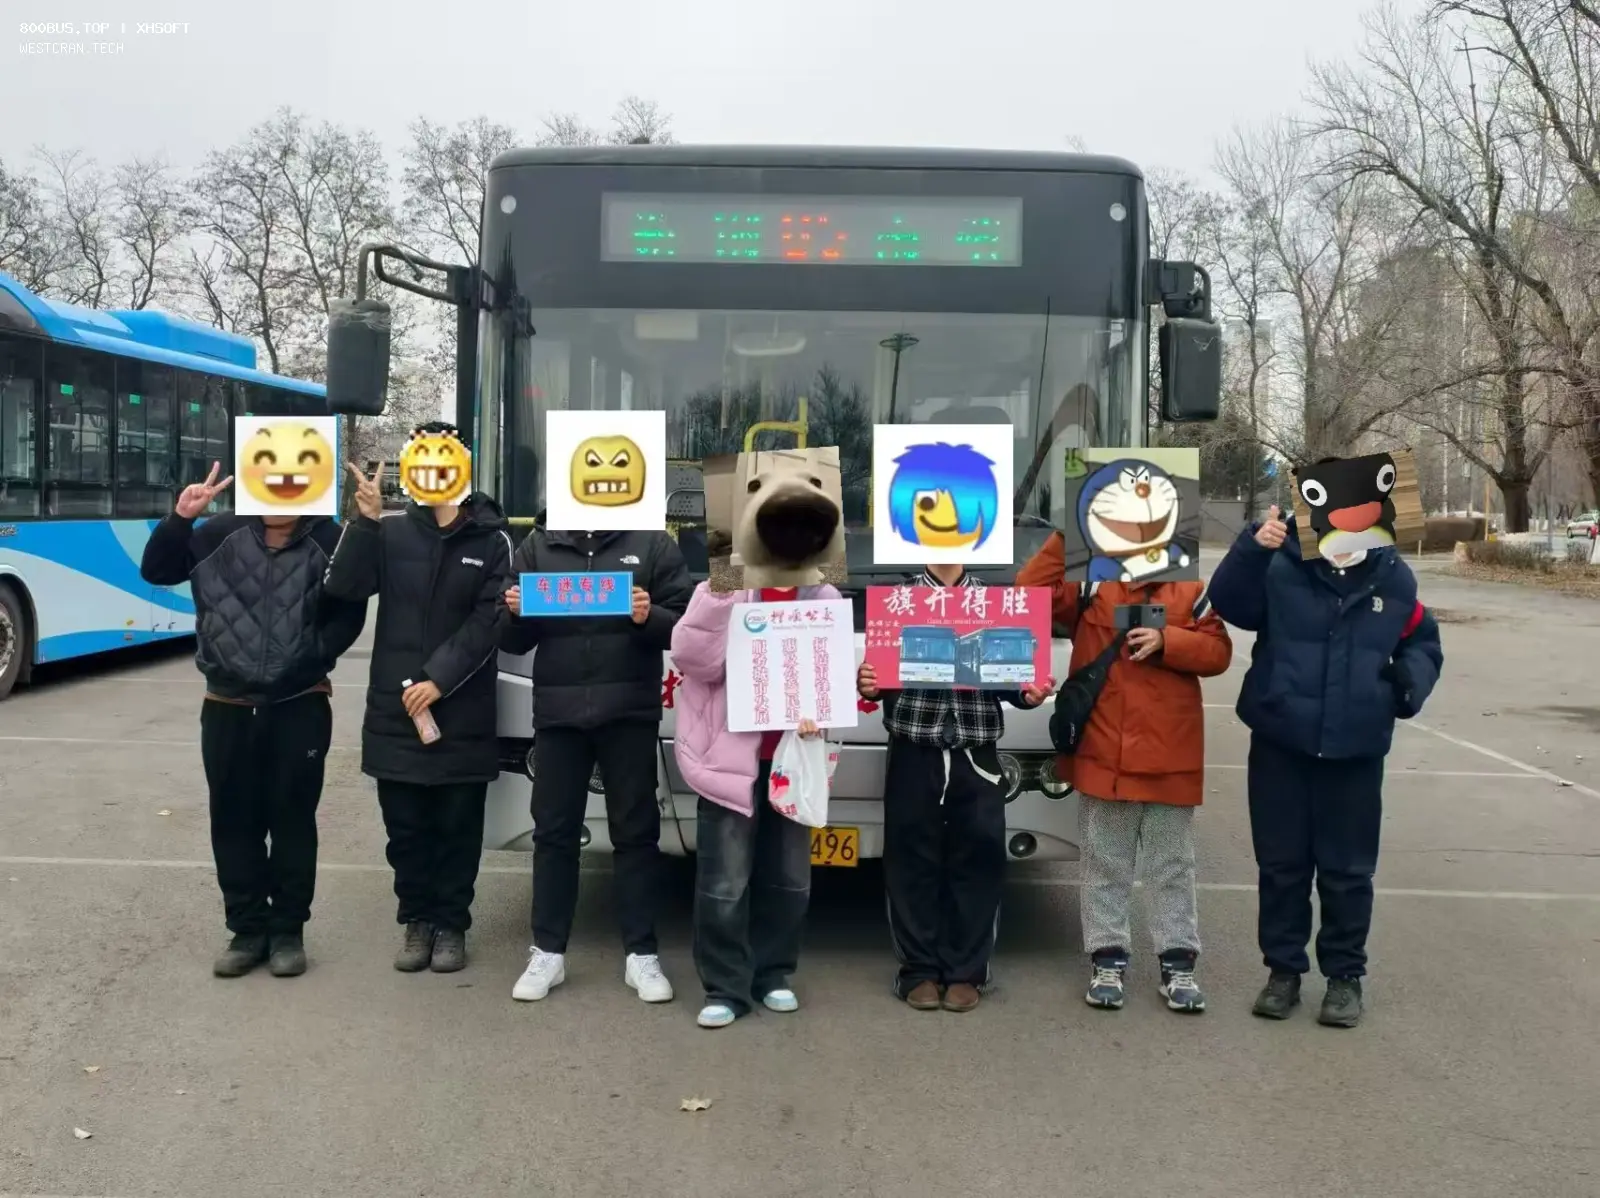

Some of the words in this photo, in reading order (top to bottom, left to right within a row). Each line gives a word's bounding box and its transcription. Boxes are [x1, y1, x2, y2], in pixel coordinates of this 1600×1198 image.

[537, 576, 616, 592] 车迷专线
[883, 586, 1030, 619] 旗开得胜
[1371, 596, 1384, 613] B
